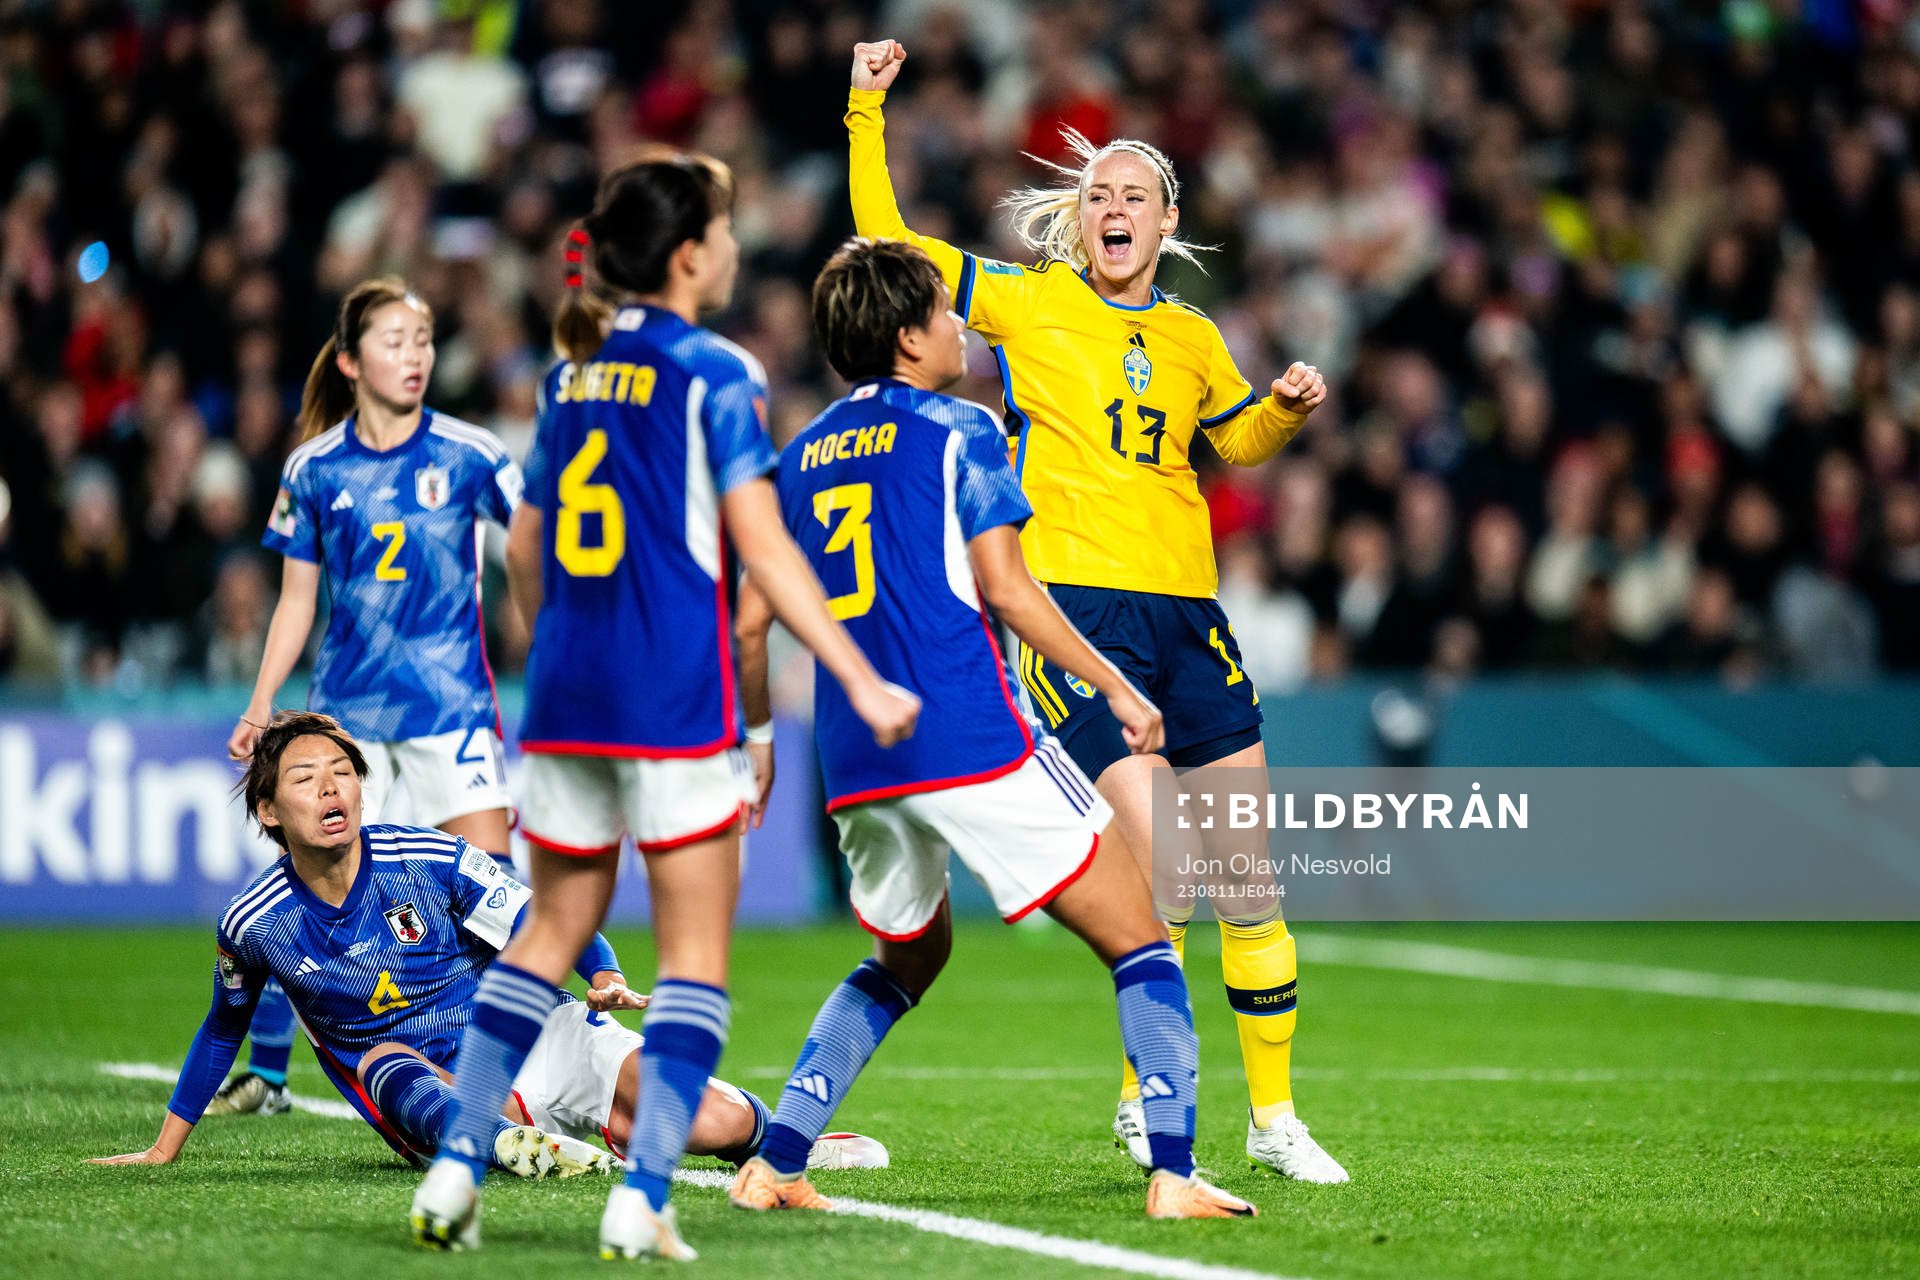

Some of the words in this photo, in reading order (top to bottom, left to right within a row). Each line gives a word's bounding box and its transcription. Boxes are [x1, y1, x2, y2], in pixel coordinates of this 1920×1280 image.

[801, 422, 897, 472] MOEKA
[1104, 397, 1166, 465] 13
[555, 428, 626, 577] 6
[372, 521, 407, 581] 2
[813, 482, 876, 620] 3
[367, 970, 411, 1016] 4
